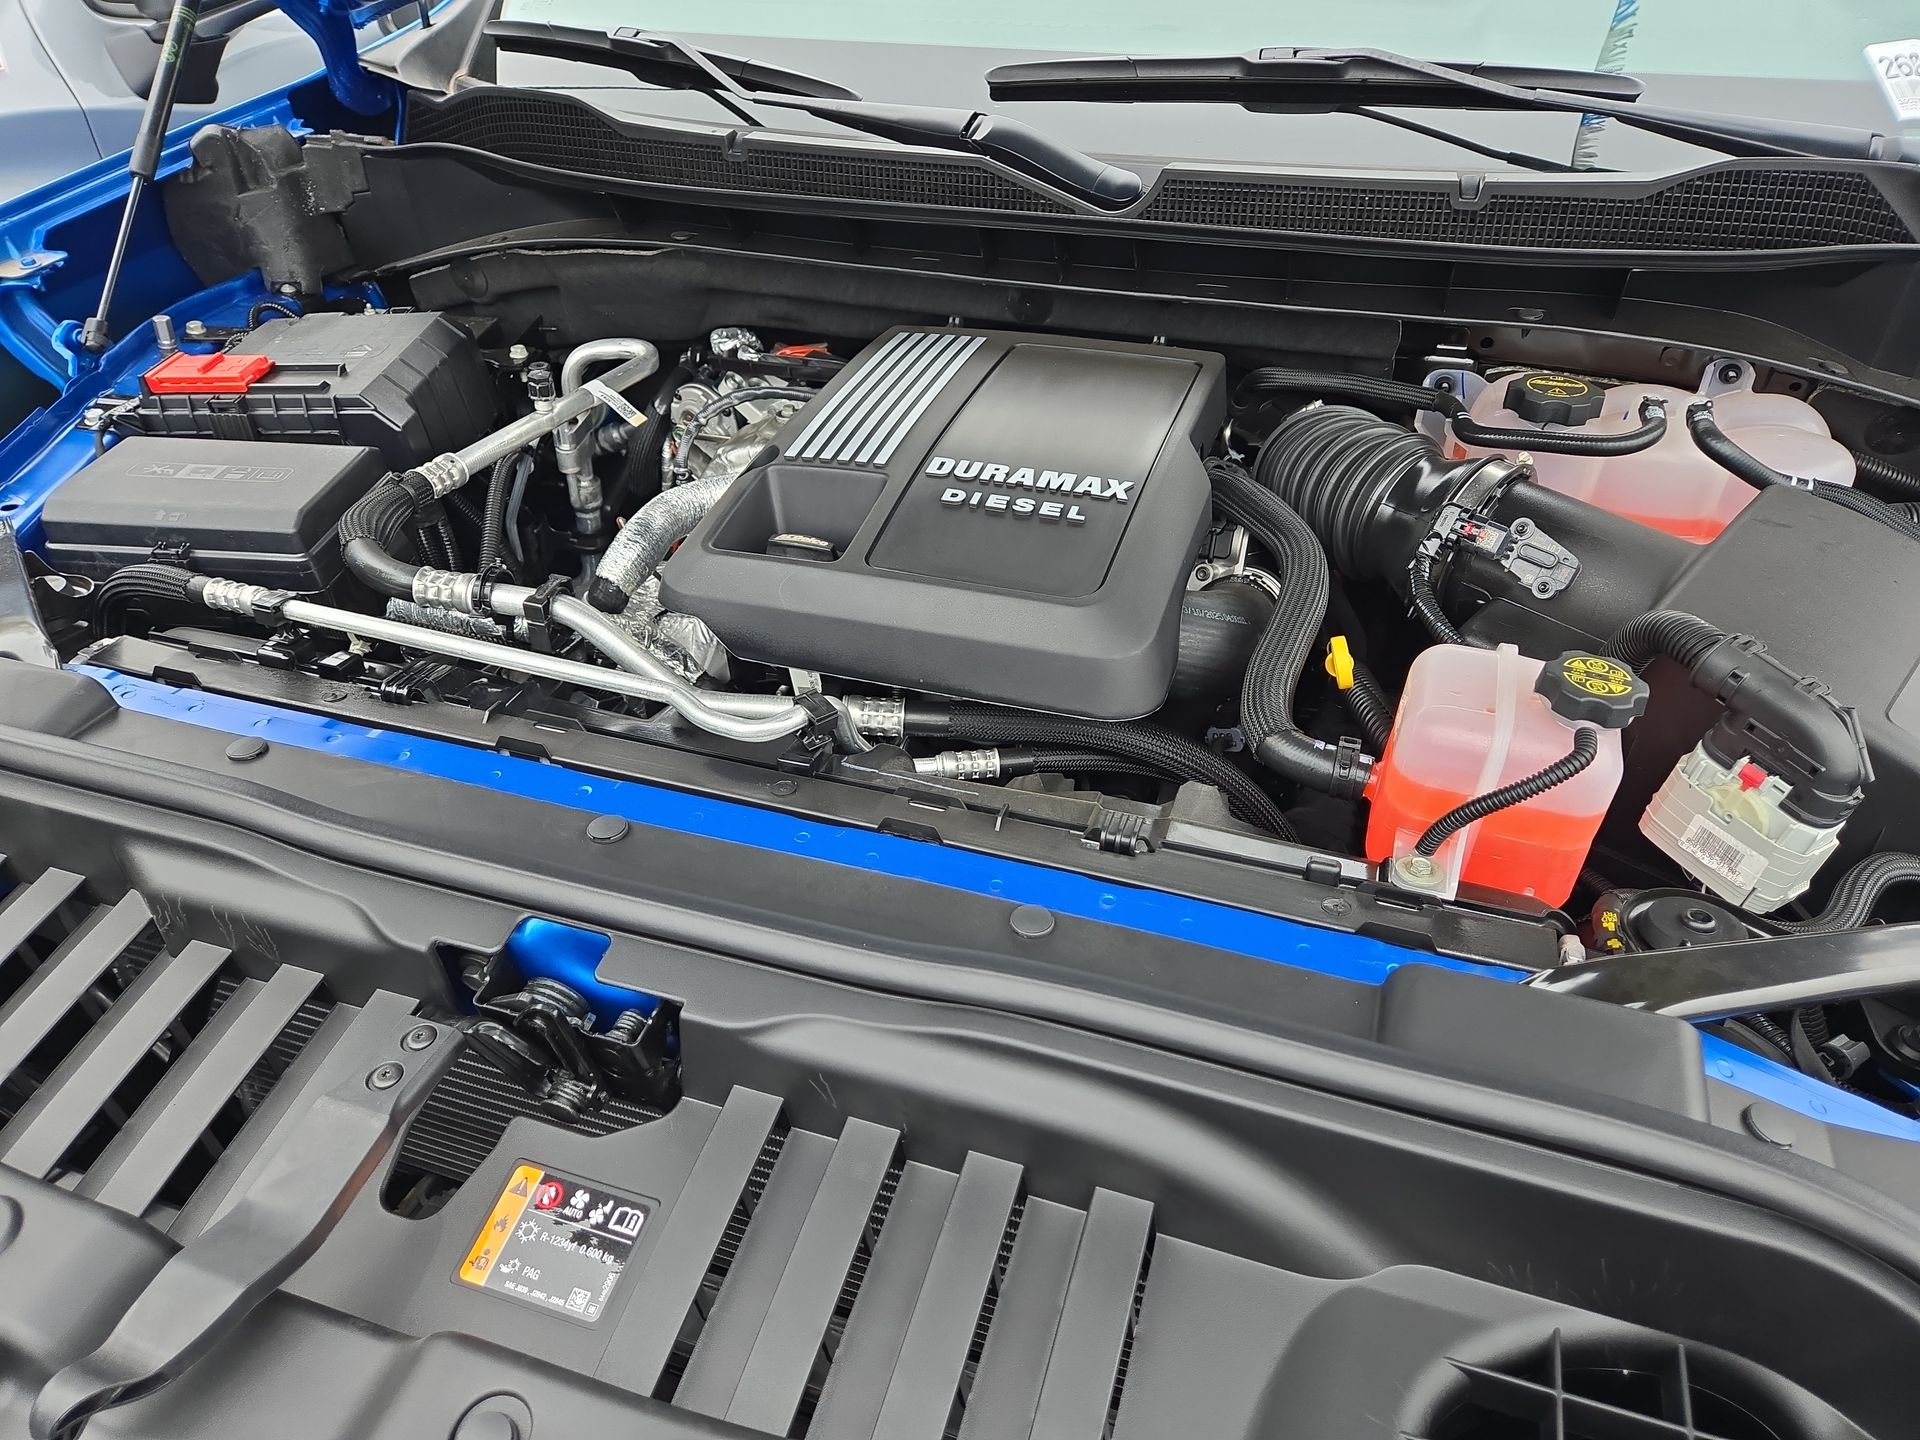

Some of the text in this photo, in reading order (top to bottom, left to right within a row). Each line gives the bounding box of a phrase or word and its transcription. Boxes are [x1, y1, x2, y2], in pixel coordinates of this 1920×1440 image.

[925, 456, 1135, 504] DURAMAX
[940, 487, 1087, 525] DIESEL
[562, 1205, 584, 1220] AUTO
[539, 1231, 615, 1265] R-1234yf 0.600 kg
[504, 1280, 517, 1290] SAE
[521, 1266, 541, 1281] PAG
